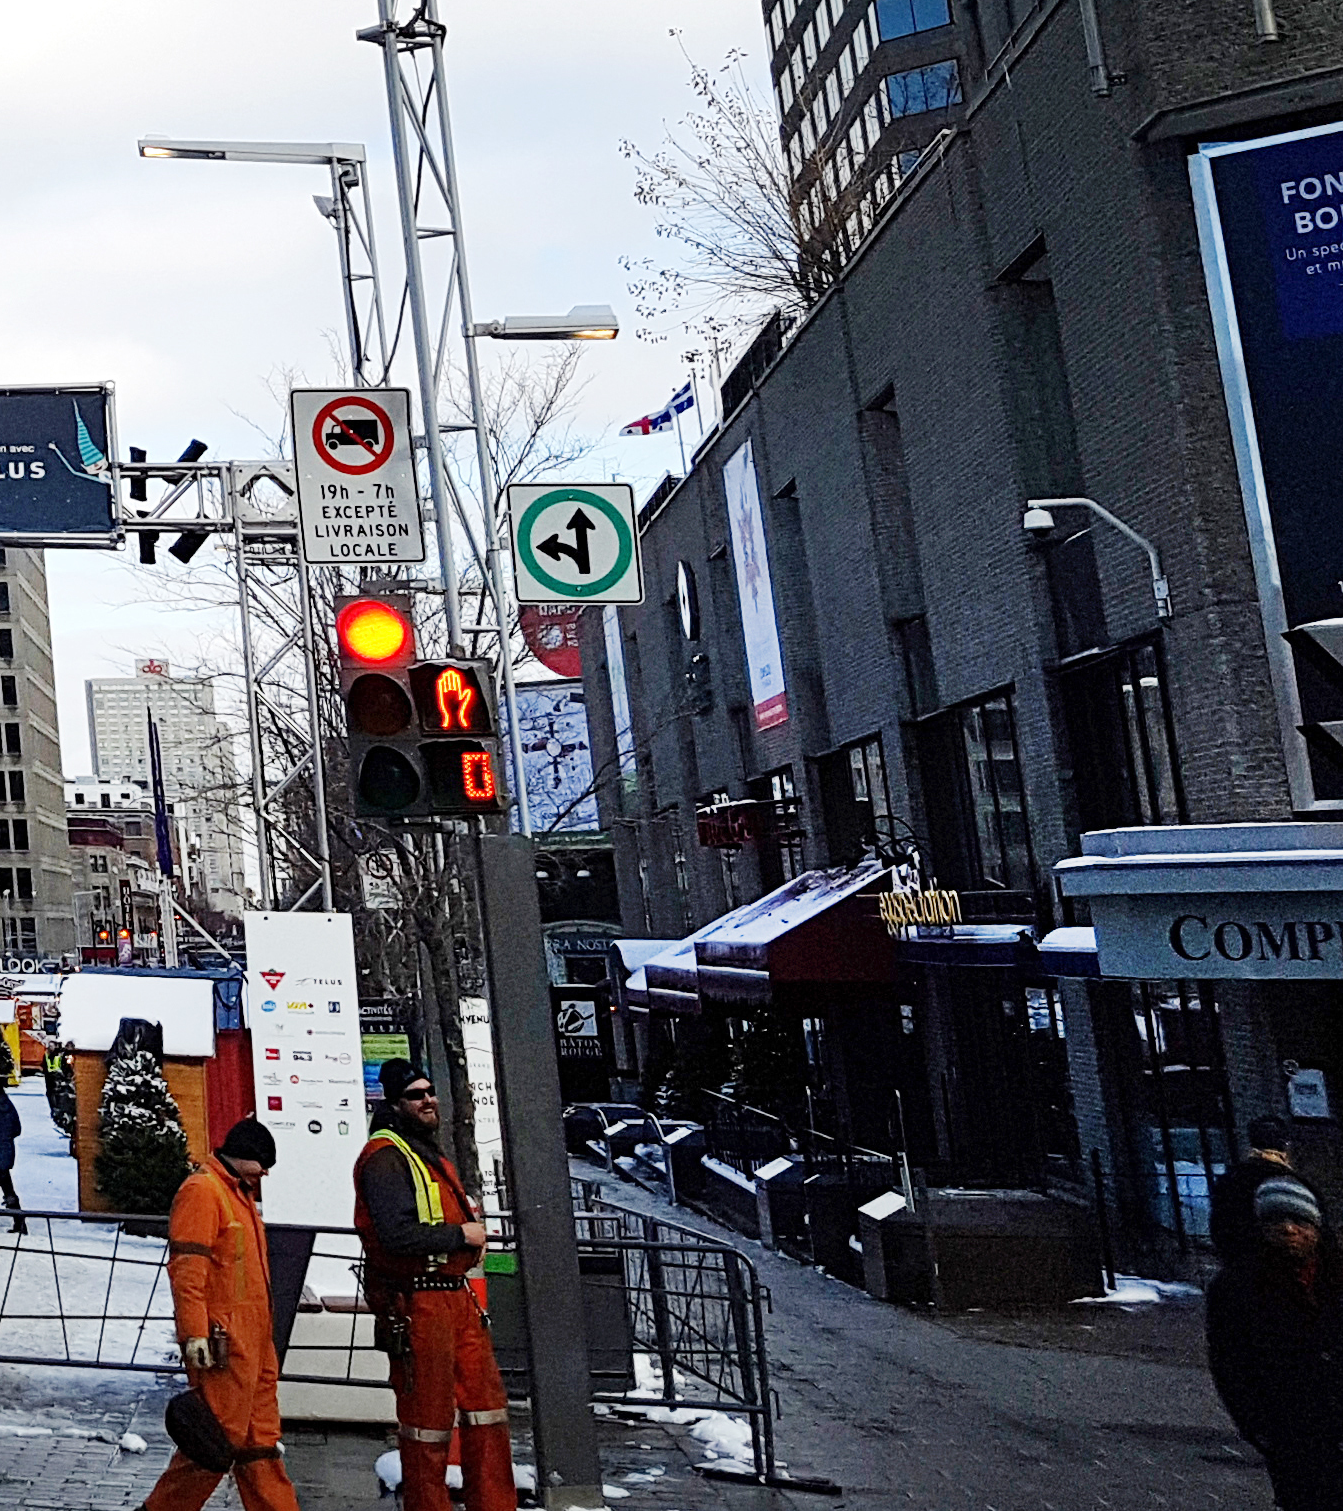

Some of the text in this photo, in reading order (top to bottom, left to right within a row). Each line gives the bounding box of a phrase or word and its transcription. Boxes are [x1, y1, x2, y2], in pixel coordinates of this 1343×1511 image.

[1295, 204, 1343, 234] BO
[1286, 247, 1307, 261] Un
[1306, 260, 1343, 275] et m
[9, 445, 35, 453] avec
[320, 484, 350, 500] 19h
[372, 483, 395, 500] 7h
[322, 500, 398, 519] EXCEPTÉ
[315, 523, 409, 538] LIVRAISON
[330, 542, 398, 557] LOCALE
[121, 886, 134, 930] HOTEL
[1169, 914, 1343, 961] COMP
[314, 978, 342, 986] TELUS
[560, 1047, 603, 1057] ROUGE
